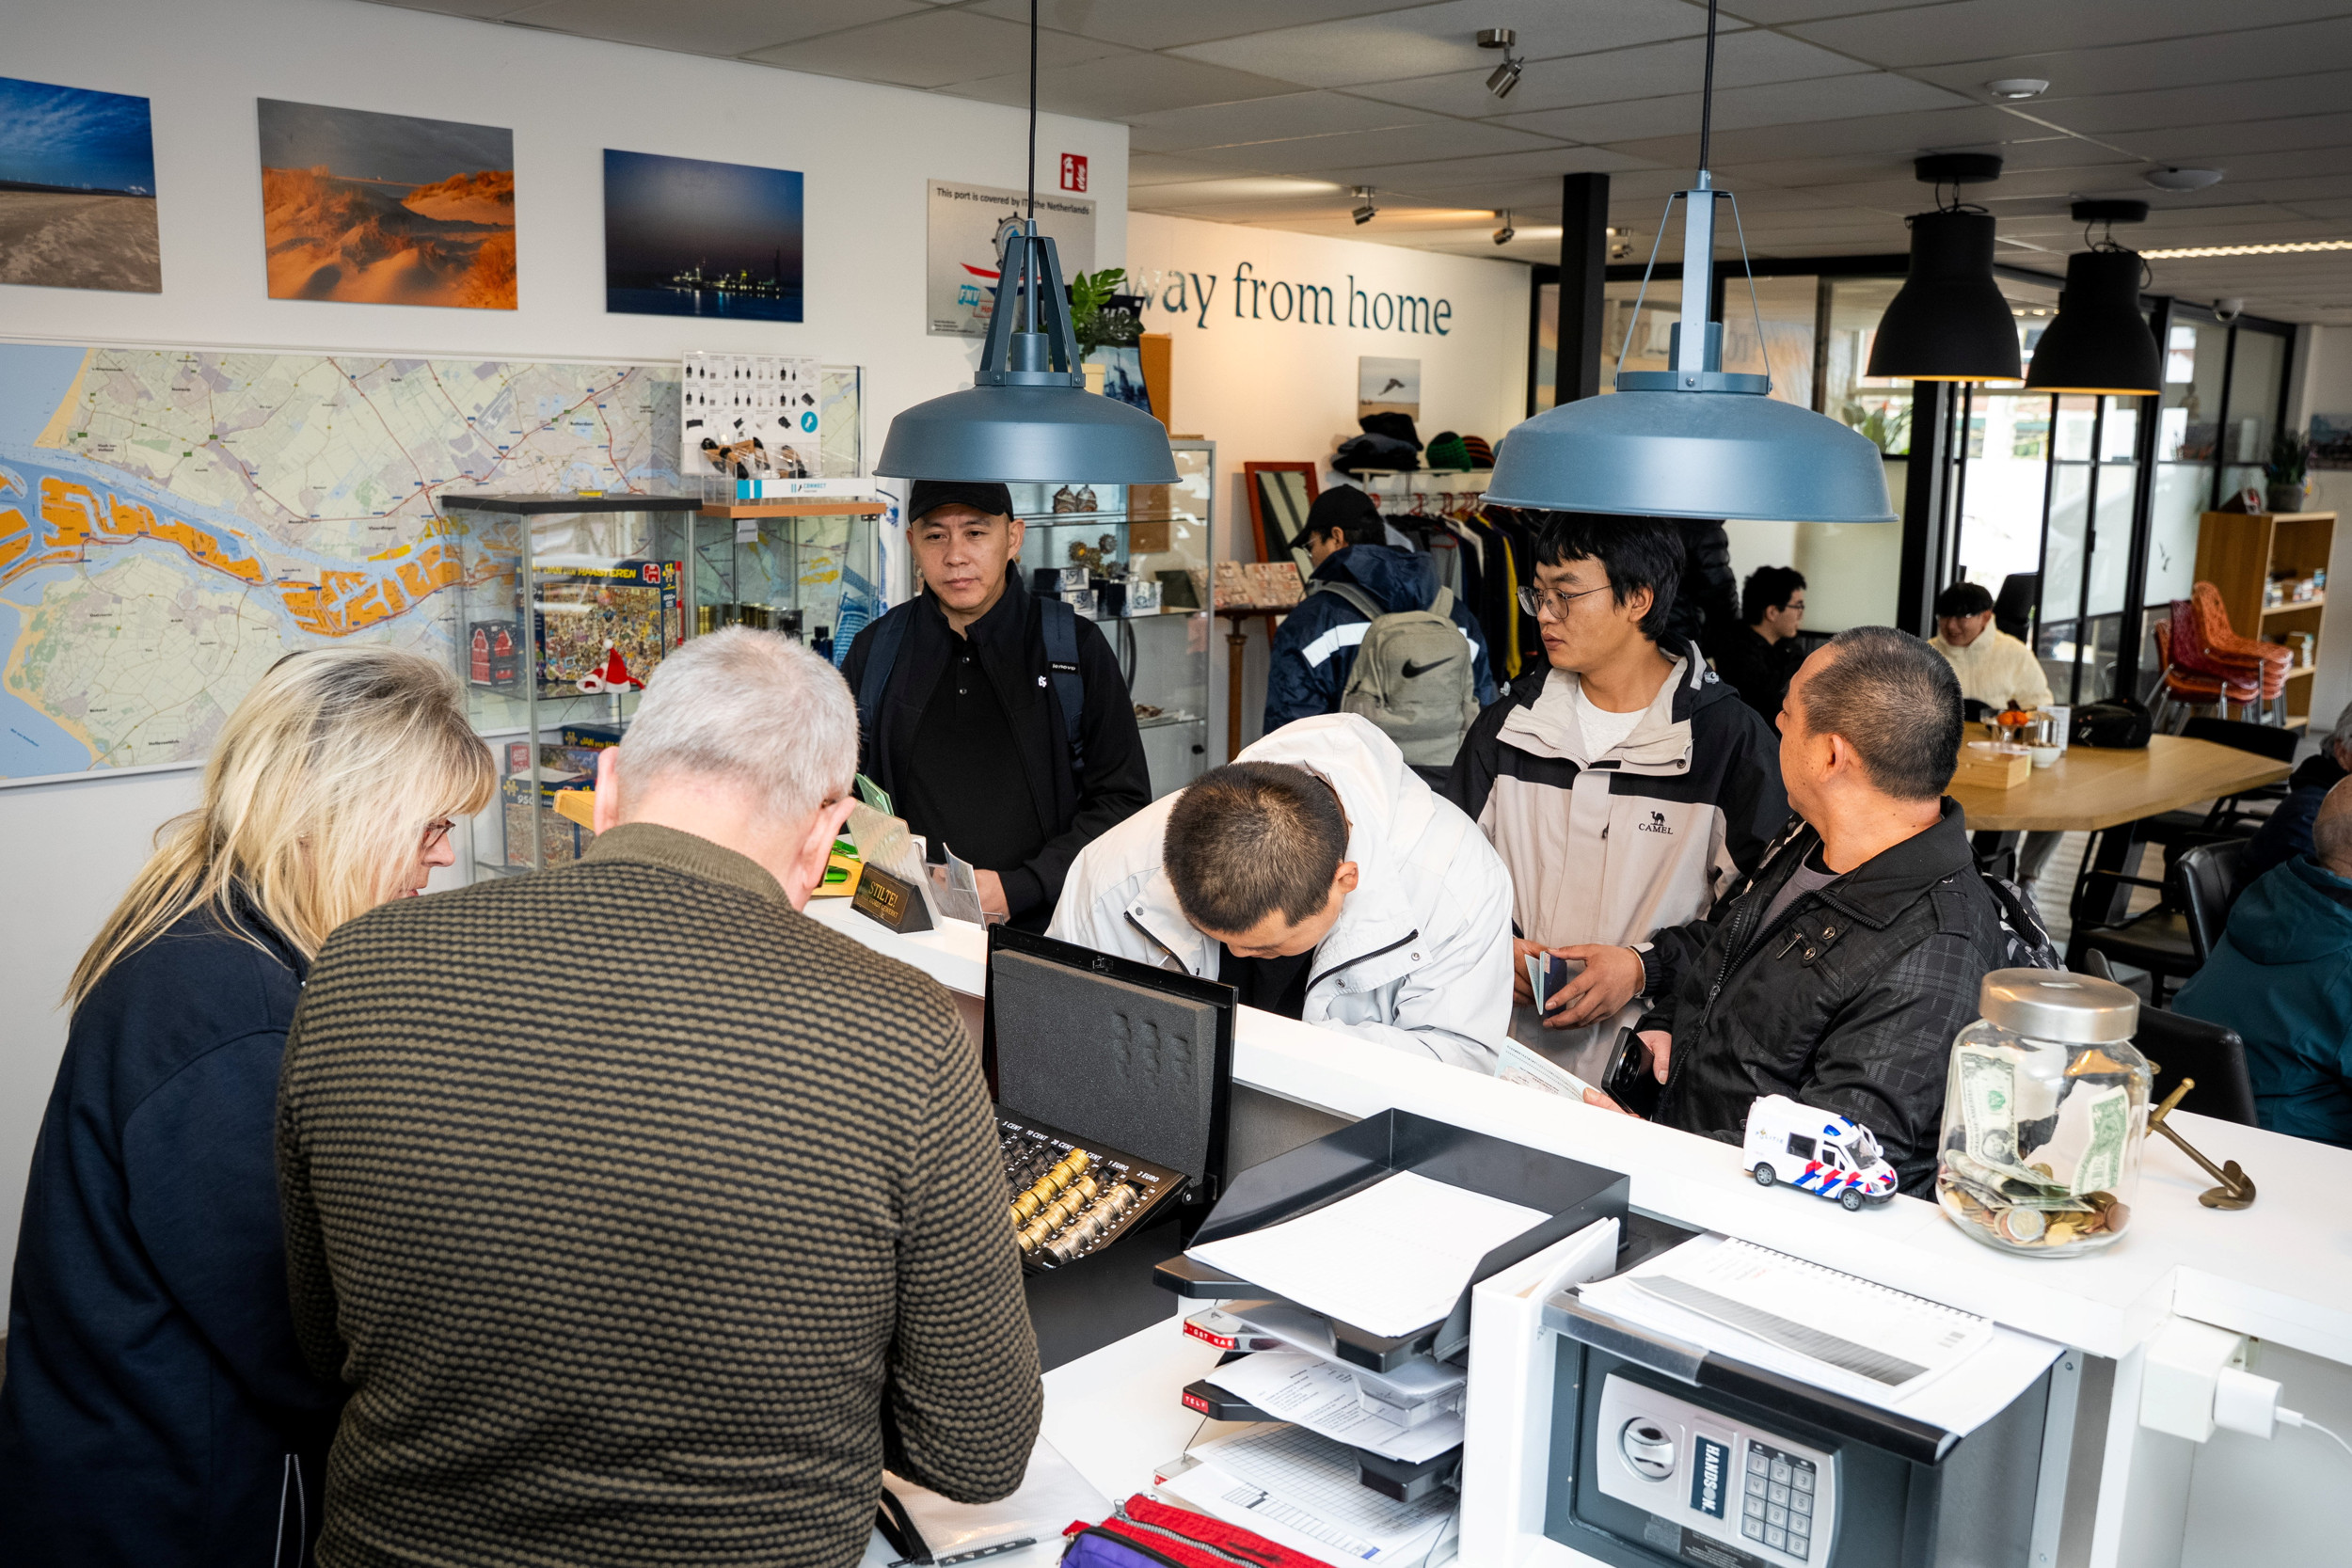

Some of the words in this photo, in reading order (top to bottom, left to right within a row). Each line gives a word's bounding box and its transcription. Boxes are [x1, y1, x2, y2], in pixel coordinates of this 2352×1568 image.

[937, 188, 953, 198] This
[954, 191, 971, 201] port
[972, 192, 978, 201] is
[980, 193, 1009, 205] covered
[1011, 197, 1021, 207] by
[1035, 199, 1045, 210] the
[1047, 201, 1090, 215] Netherlands
[961, 288, 980, 303] FNV
[1233, 261, 1336, 325] from
[1347, 275, 1453, 336] home
[1638, 823, 1674, 835] CAMEL
[869, 881, 898, 908] STILTE!
[1007, 1122, 1024, 1132] CENT
[1033, 1132, 1049, 1141] CENT
[1058, 1141, 1075, 1151] CENT
[1086, 1150, 1103, 1162] CENT
[1111, 1162, 1129, 1171] EURO
[1141, 1172, 1160, 1183] EURO
